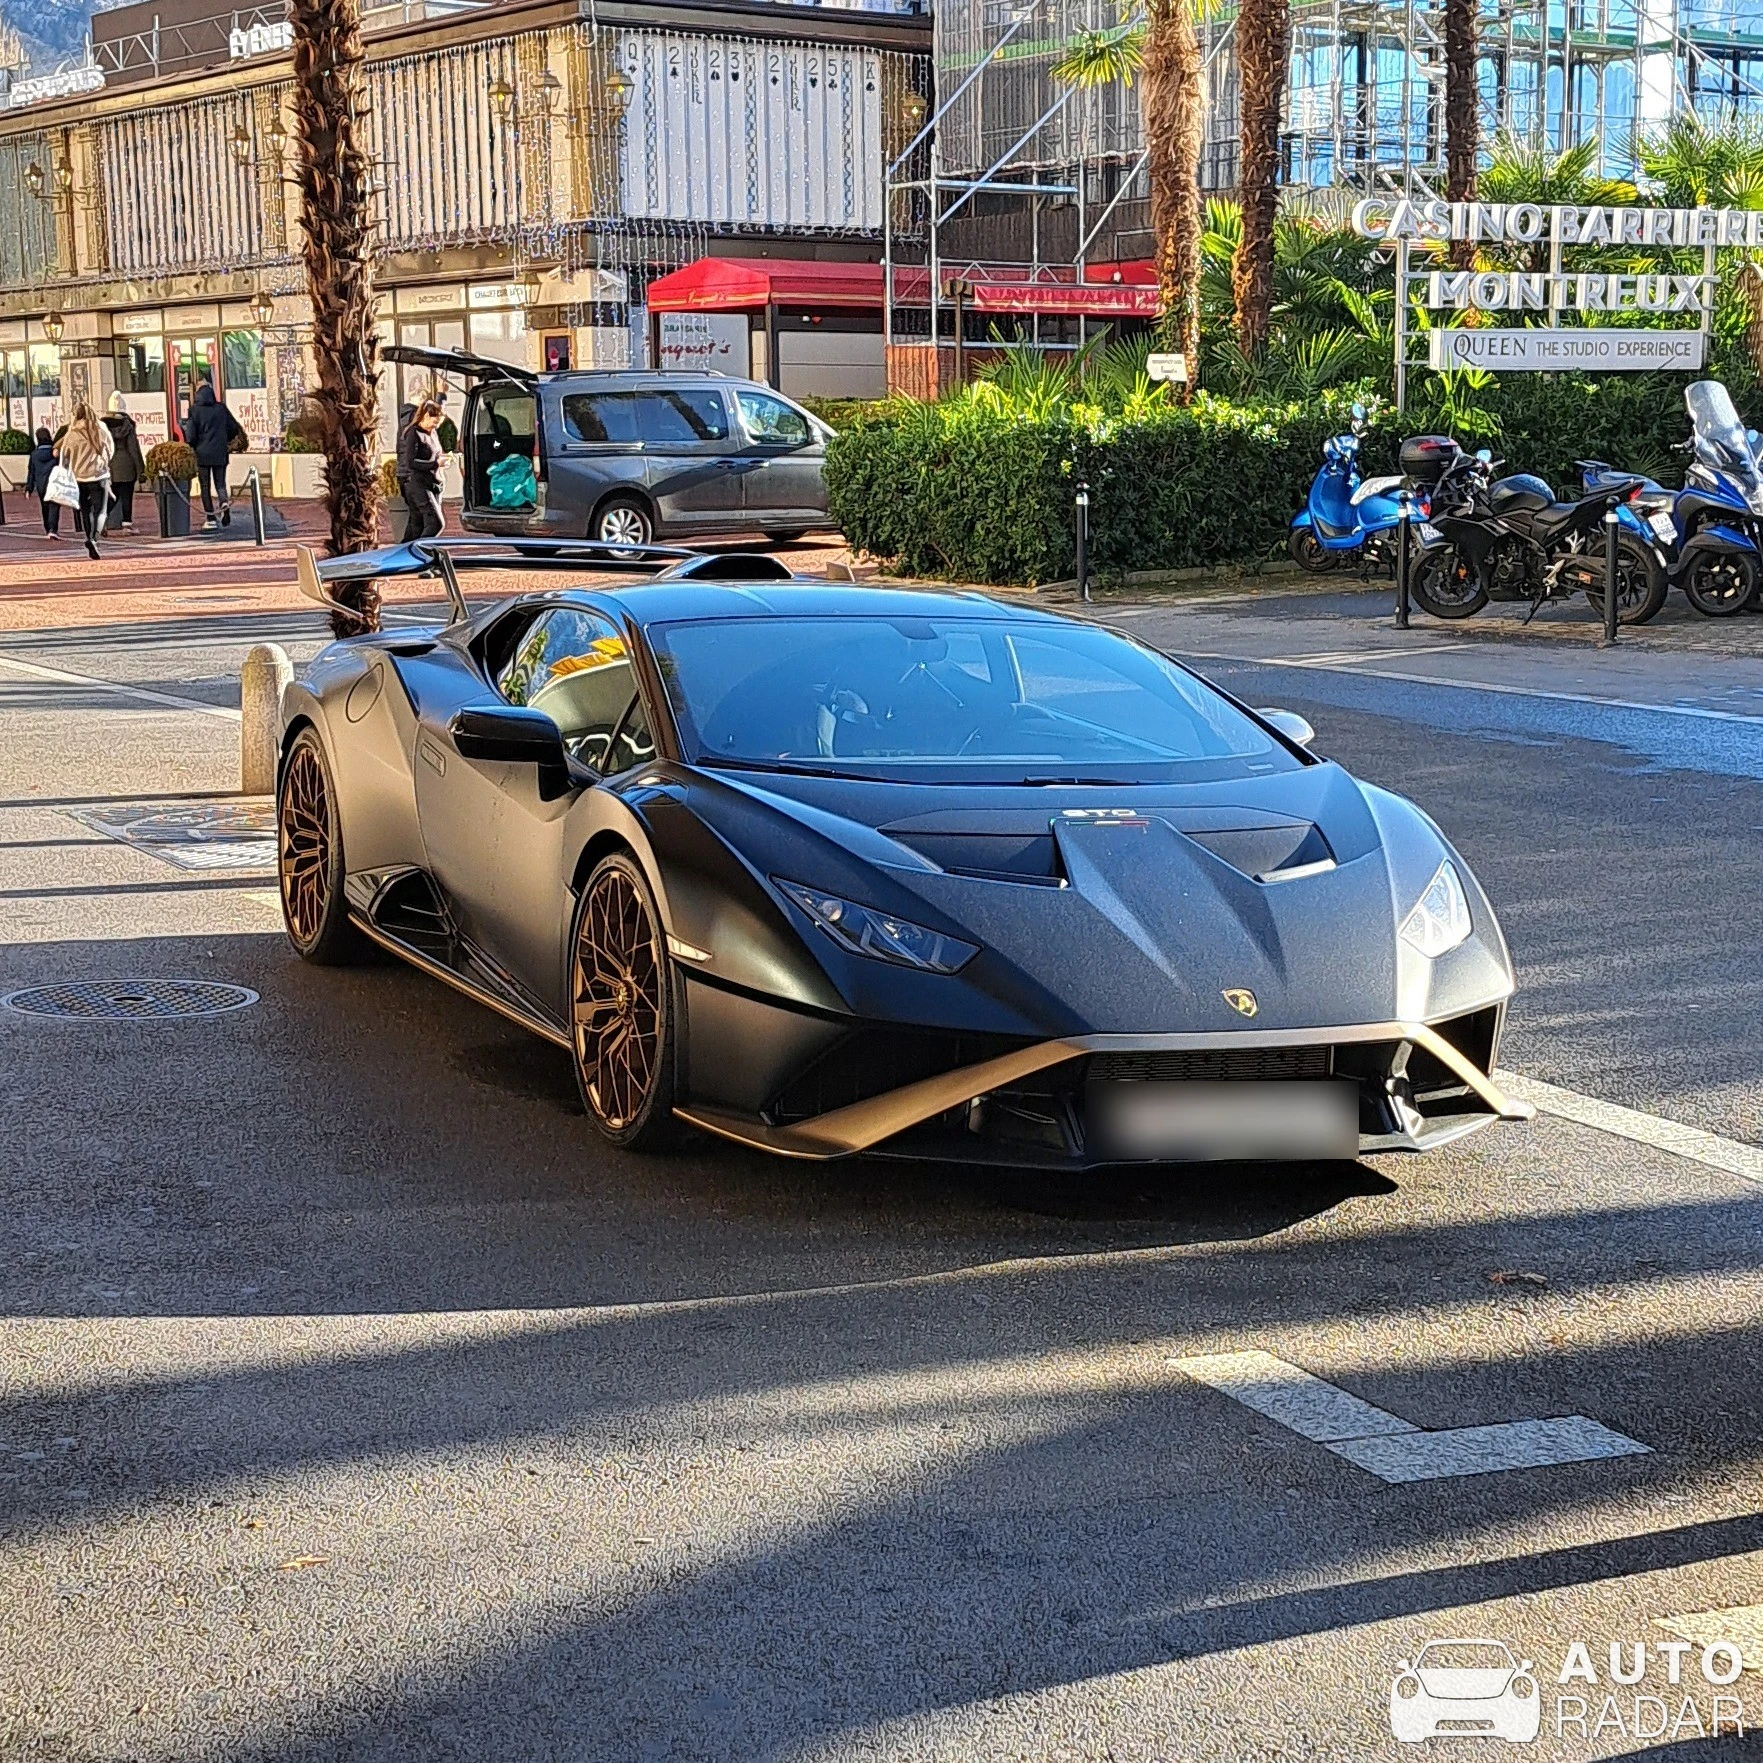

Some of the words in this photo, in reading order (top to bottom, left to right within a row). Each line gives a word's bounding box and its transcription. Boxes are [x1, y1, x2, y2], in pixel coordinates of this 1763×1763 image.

[628, 42, 638, 62] Q
[668, 46, 681, 65] 2
[709, 50, 720, 68] 2
[730, 51, 740, 70] 3
[769, 54, 780, 73] 2
[807, 57, 819, 76] 2
[828, 58, 838, 77] 5
[865, 61, 876, 80] K
[1352, 199, 1543, 242] CASINO
[1430, 271, 1702, 310] MONTREUX
[1453, 334, 1528, 366] QUEEN
[1536, 342, 1559, 357] THE
[1562, 341, 1609, 357] STUDIO
[1617, 341, 1692, 357] EXPERIENCE
